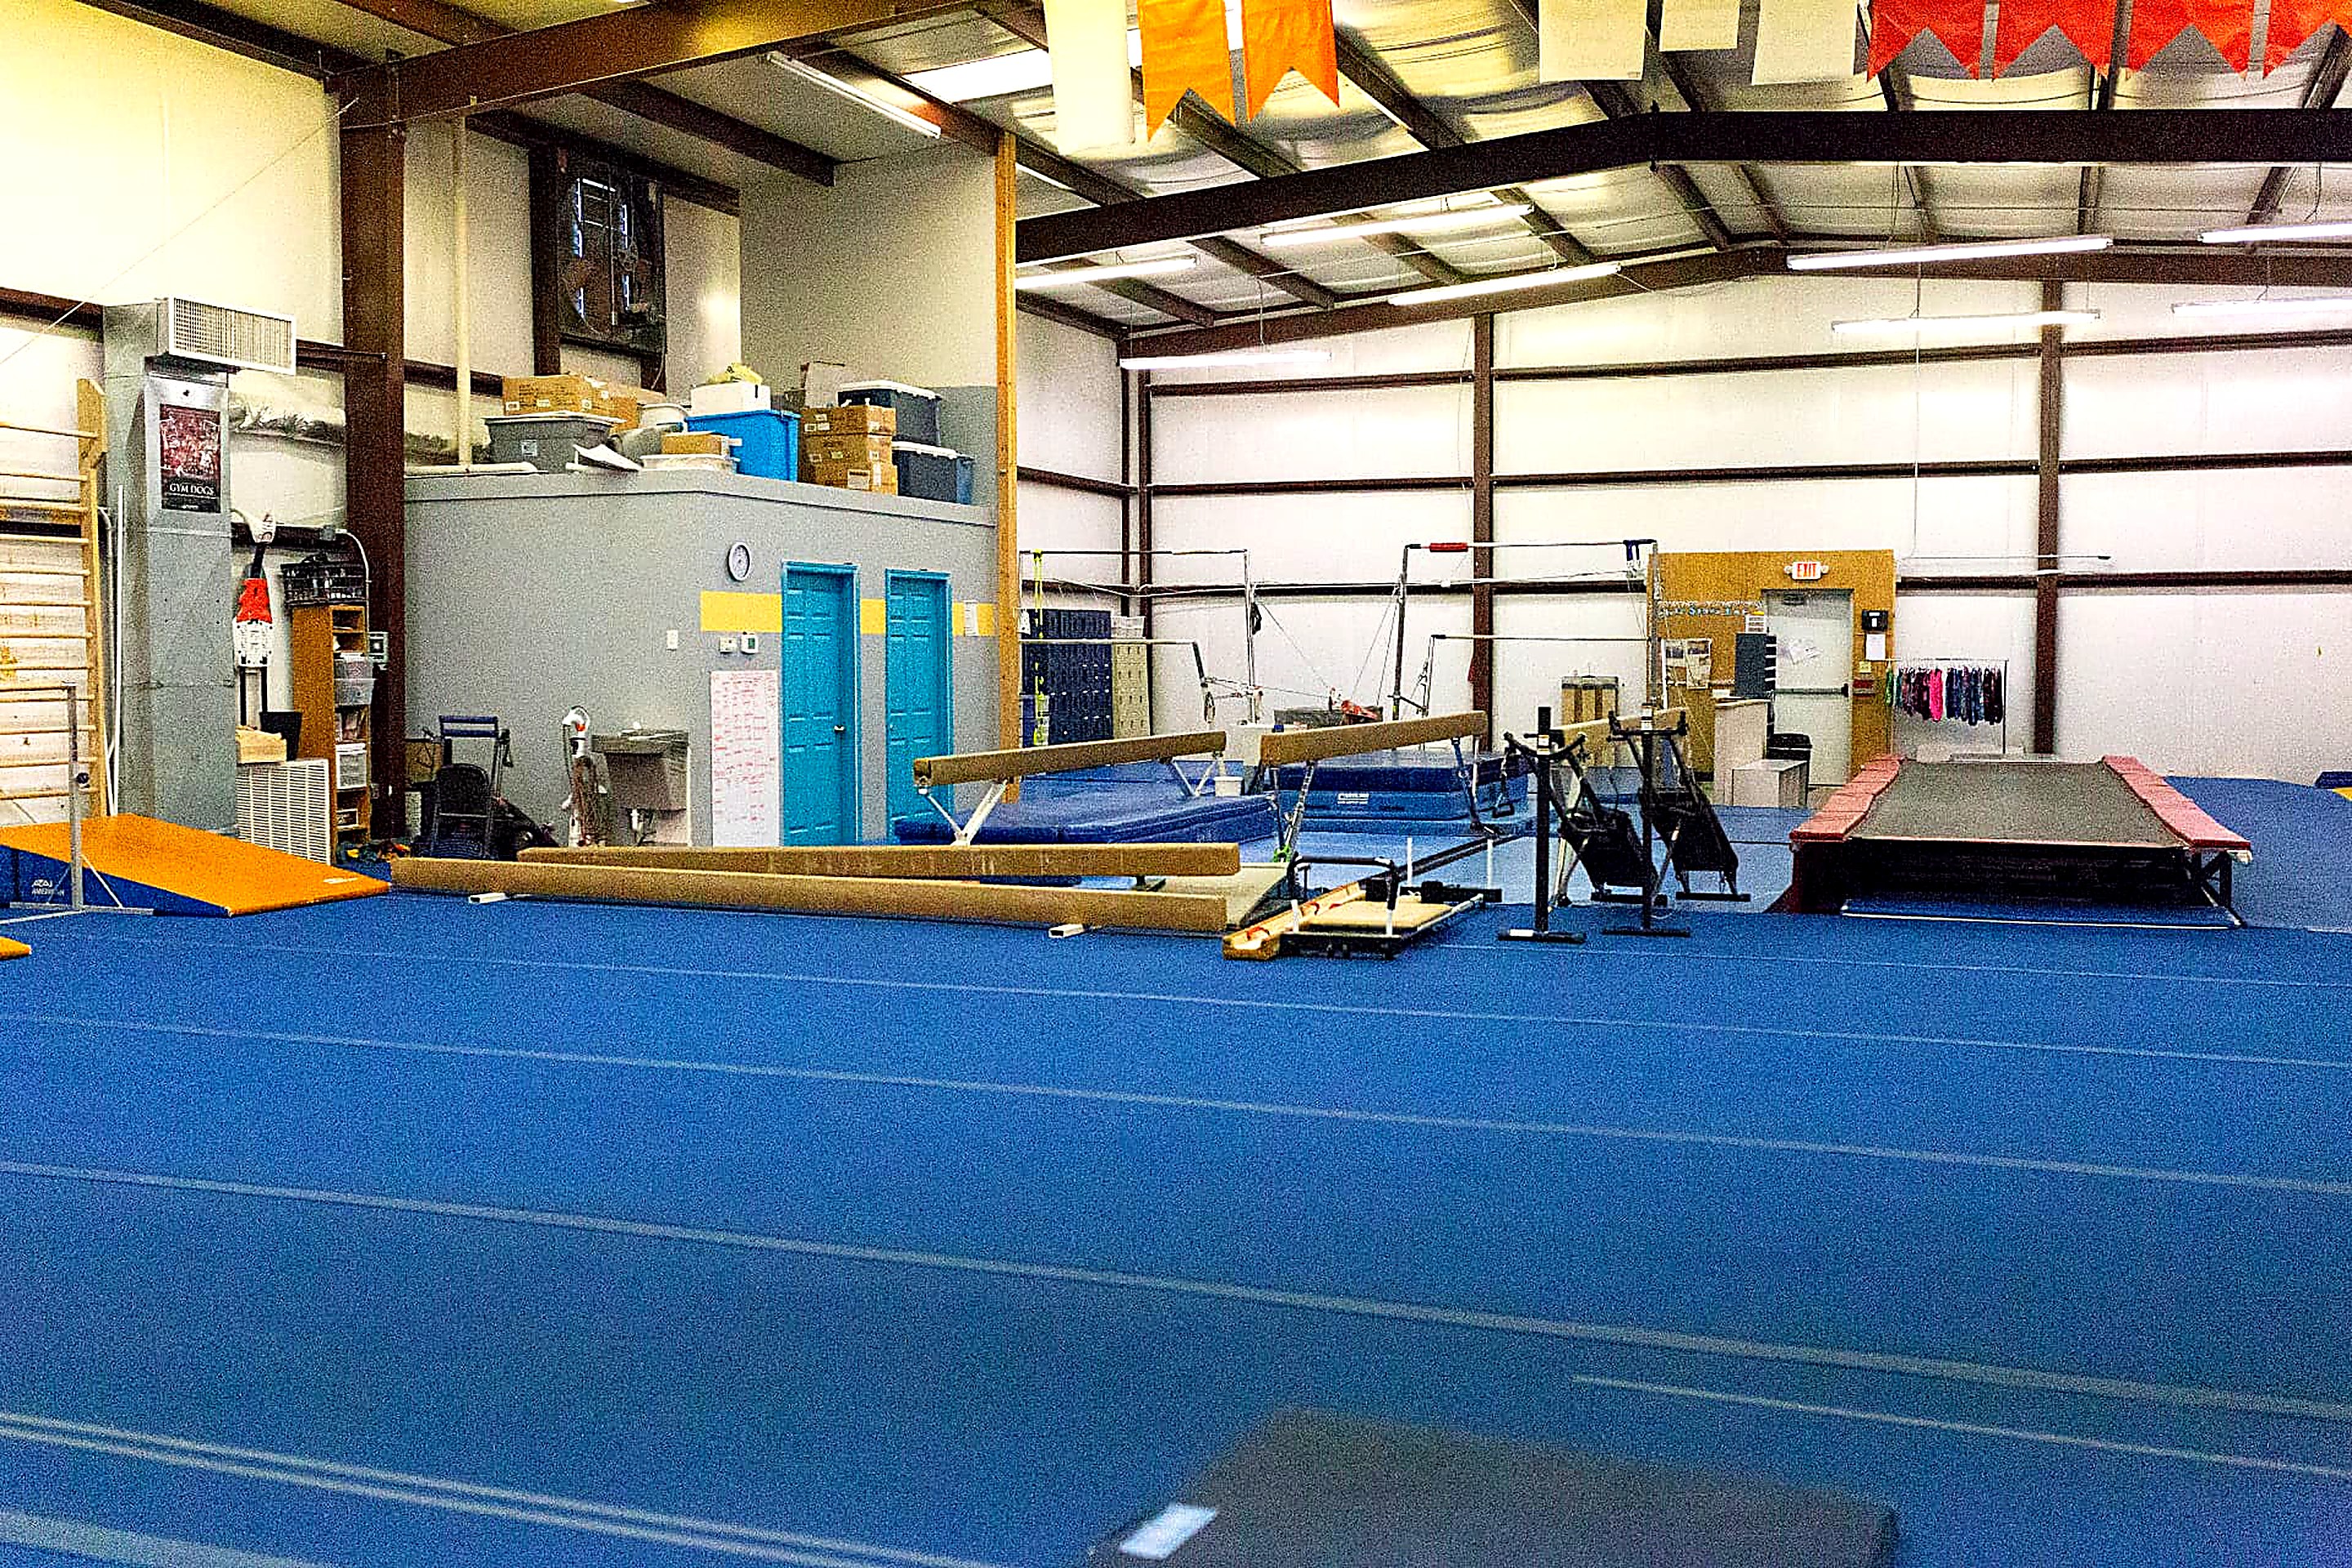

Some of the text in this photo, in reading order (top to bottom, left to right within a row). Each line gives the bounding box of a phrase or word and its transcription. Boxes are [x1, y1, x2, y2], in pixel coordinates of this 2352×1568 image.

[169, 483, 216, 497] GYM DOGS
[1797, 563, 1817, 577] EXIT
